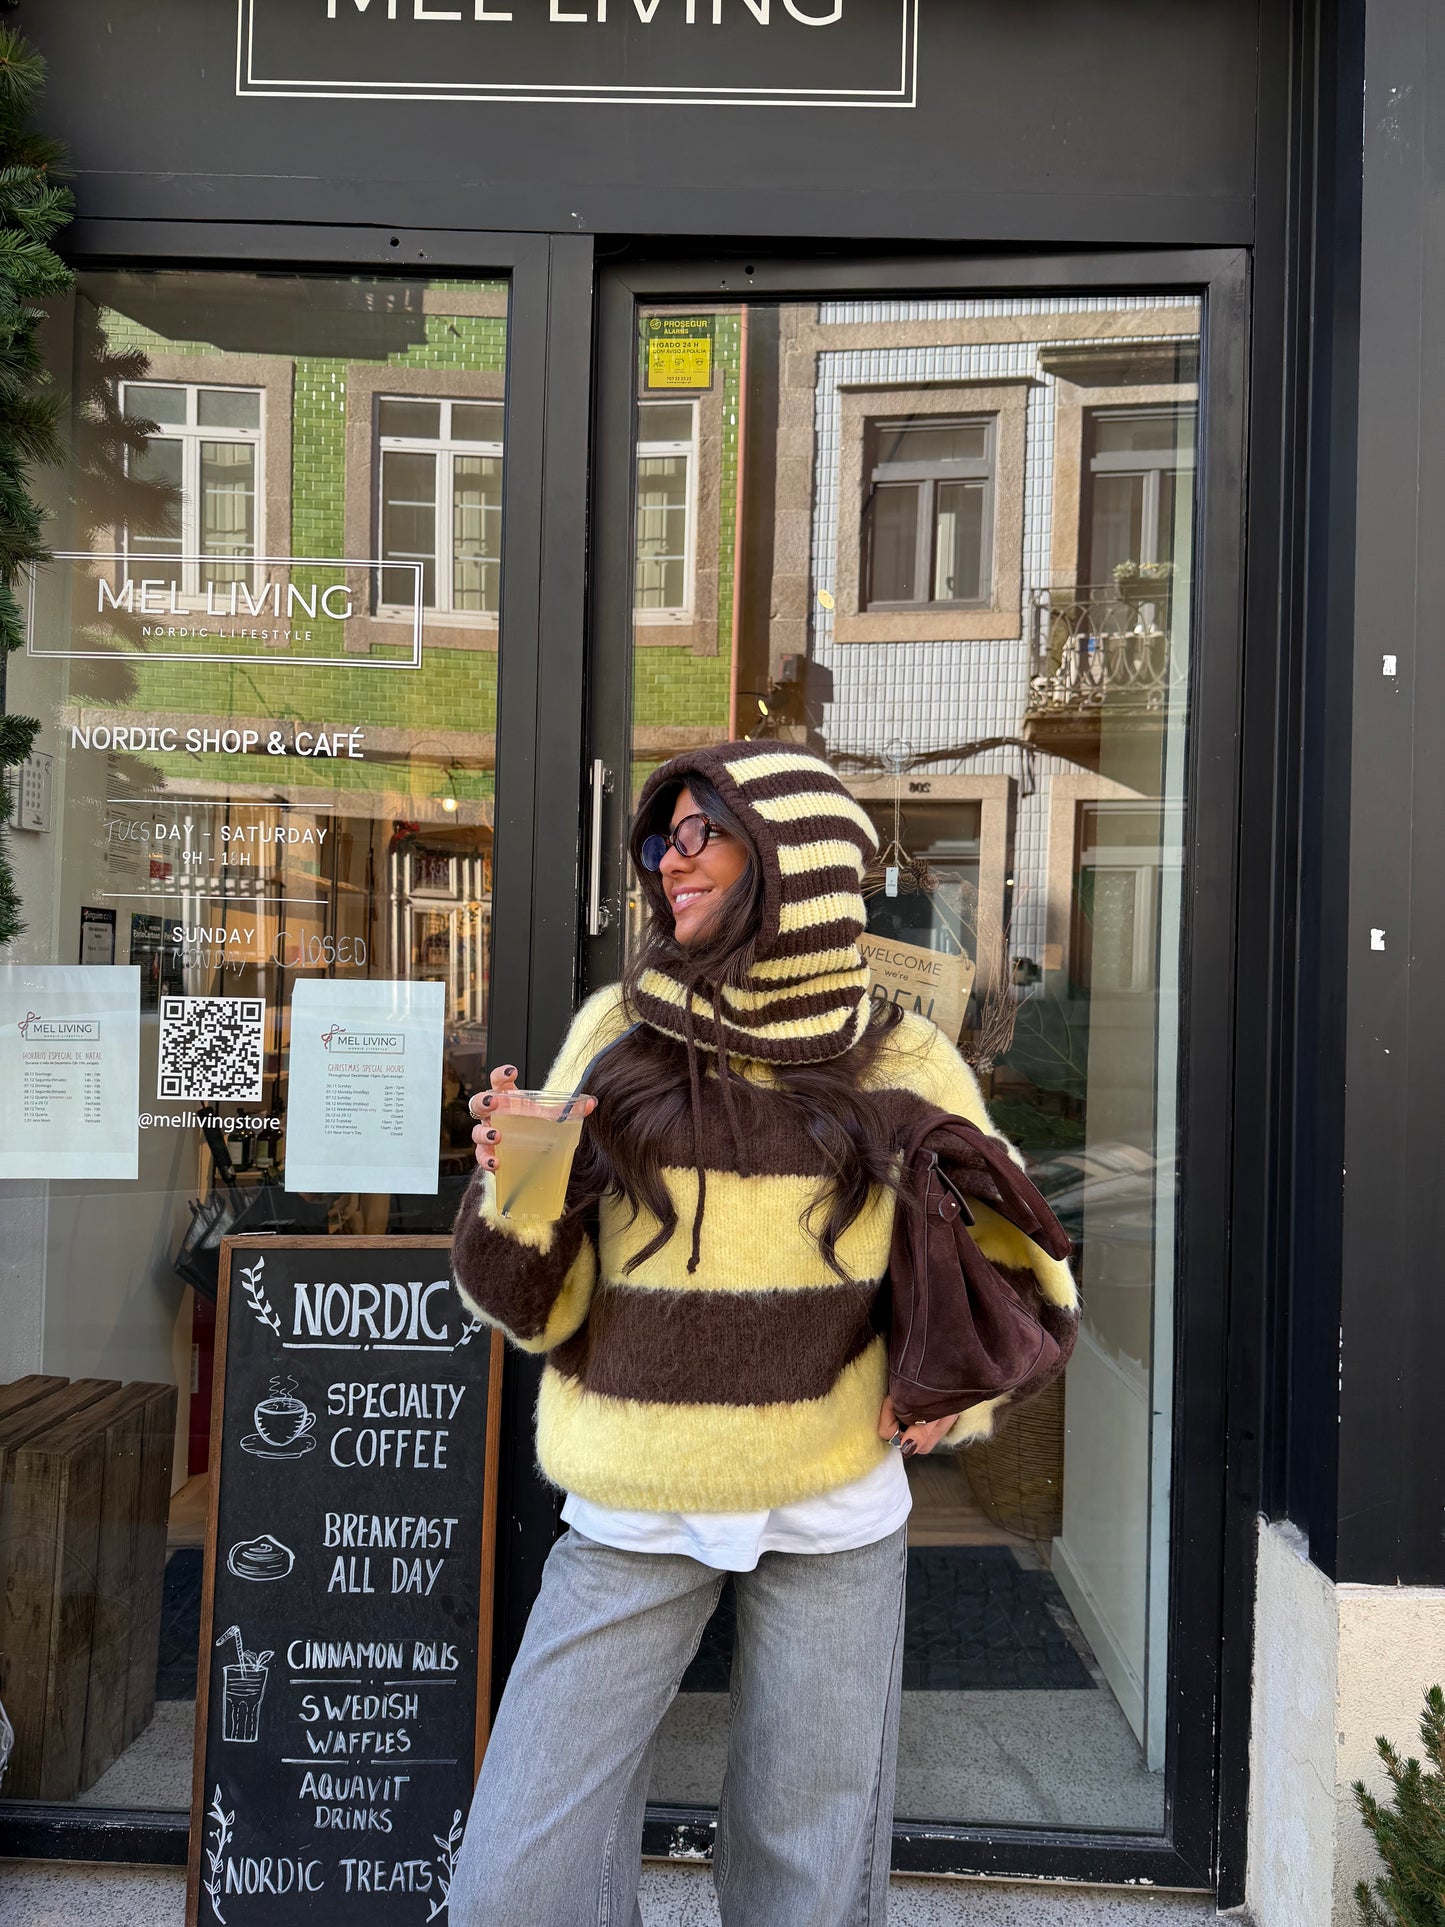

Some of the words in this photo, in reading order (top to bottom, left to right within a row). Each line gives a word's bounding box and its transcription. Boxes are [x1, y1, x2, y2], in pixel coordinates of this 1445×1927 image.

[663, 320, 708, 328] PROSEGUR
[97, 578, 190, 615] MEL
[207, 580, 353, 620] LIVING
[142, 626, 208, 638] NORDIC
[219, 628, 313, 641] LIFESTYLE
[70, 726, 178, 751] NORDIC
[185, 728, 259, 754] SHOP
[266, 730, 288, 756] &
[294, 726, 365, 758] CAFÉ
[220, 825, 328, 845] SATURDAY
[182, 851, 203, 865] 9H
[171, 926, 255, 944] SUNDAY
[860, 943, 943, 976] WELCOME
[884, 970, 909, 981] we're
[33, 1024, 56, 1033] MEL
[58, 1024, 92, 1034] LIVING
[337, 1036, 360, 1046] MEL
[363, 1036, 397, 1047] LIVING
[327, 1063, 360, 1073] CHRISTMAS
[362, 1064, 383, 1073] SPECIAL
[386, 1065, 405, 1074] HOURS
[137, 1111, 281, 1133] @mellivingstore
[292, 1280, 450, 1341] NORDIC
[327, 1382, 467, 1420] SPECIALTY
[330, 1427, 449, 1470] COFFEE
[322, 1512, 459, 1549] BREAKFAST
[327, 1555, 375, 1593] ALL
[390, 1557, 445, 1597] DAY
[306, 1728, 411, 1754] WAFFLES
[338, 1858, 433, 1894] TREATS
